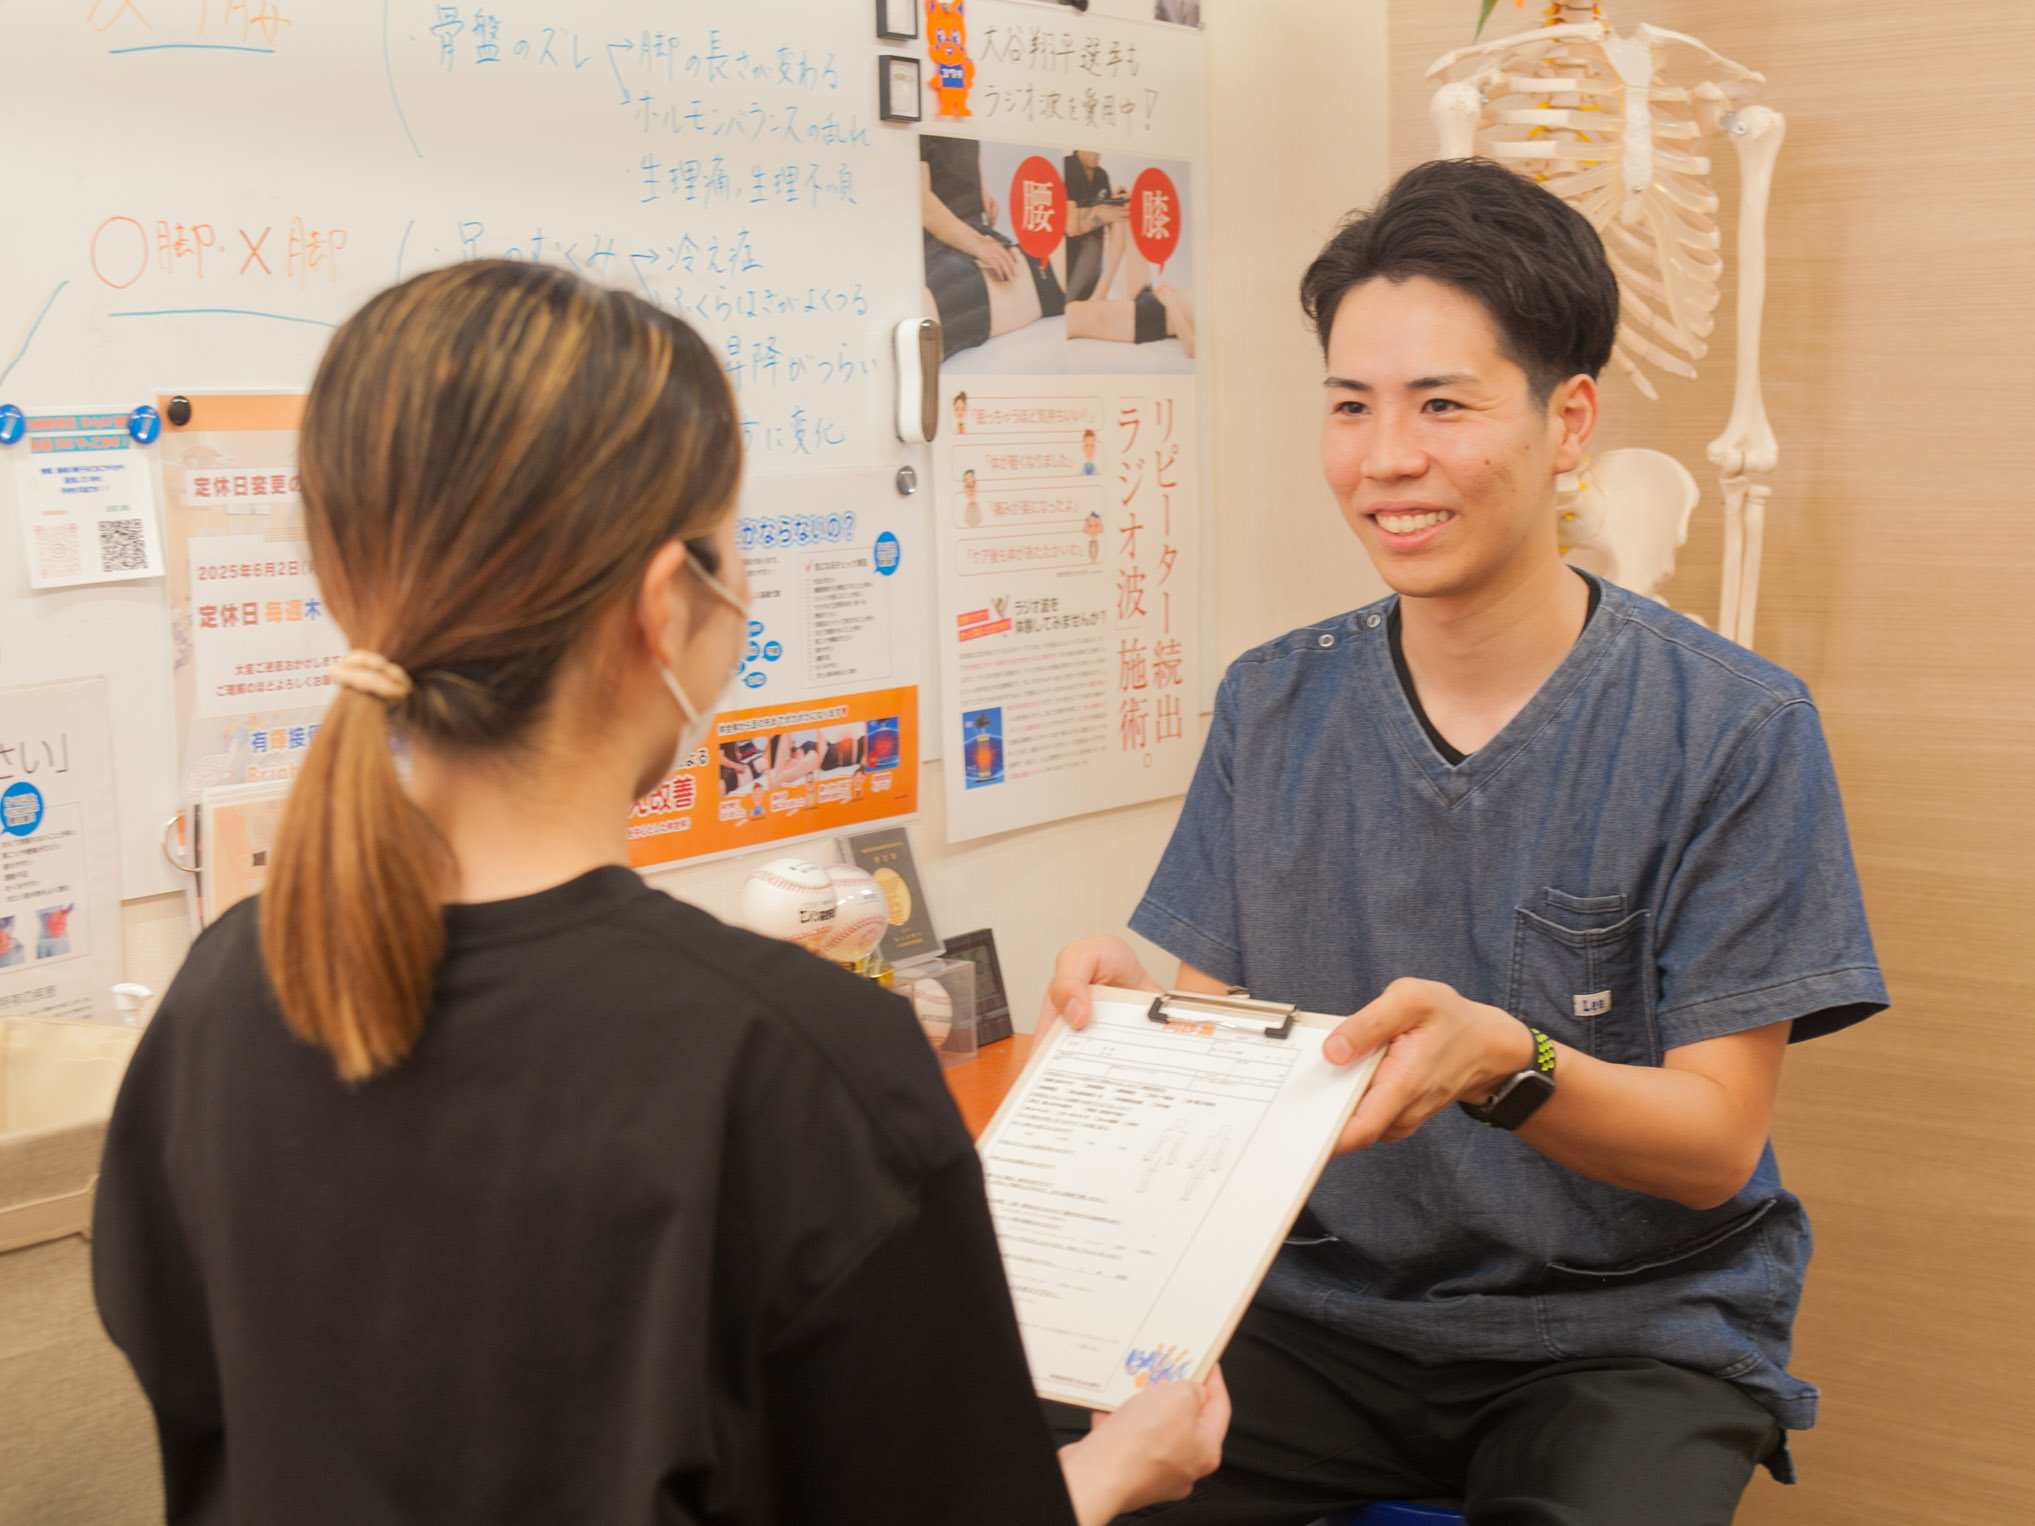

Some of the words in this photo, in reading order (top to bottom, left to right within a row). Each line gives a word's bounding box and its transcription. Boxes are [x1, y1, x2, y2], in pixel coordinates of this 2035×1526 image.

[430, 6, 590, 71] 骨盤のズレ
[638, 29, 839, 91] 脚の長さが変わる
[980, 26, 1140, 77] 大谷翔平選手も
[634, 91, 871, 147] ホルモンバランスの乱れ
[1021, 180, 1055, 232] 腰
[1141, 190, 1170, 240] 膝
[1153, 398, 1183, 744] リピーター続出
[199, 603, 257, 628] 定休日
[1583, 999, 1605, 1012] Lee
